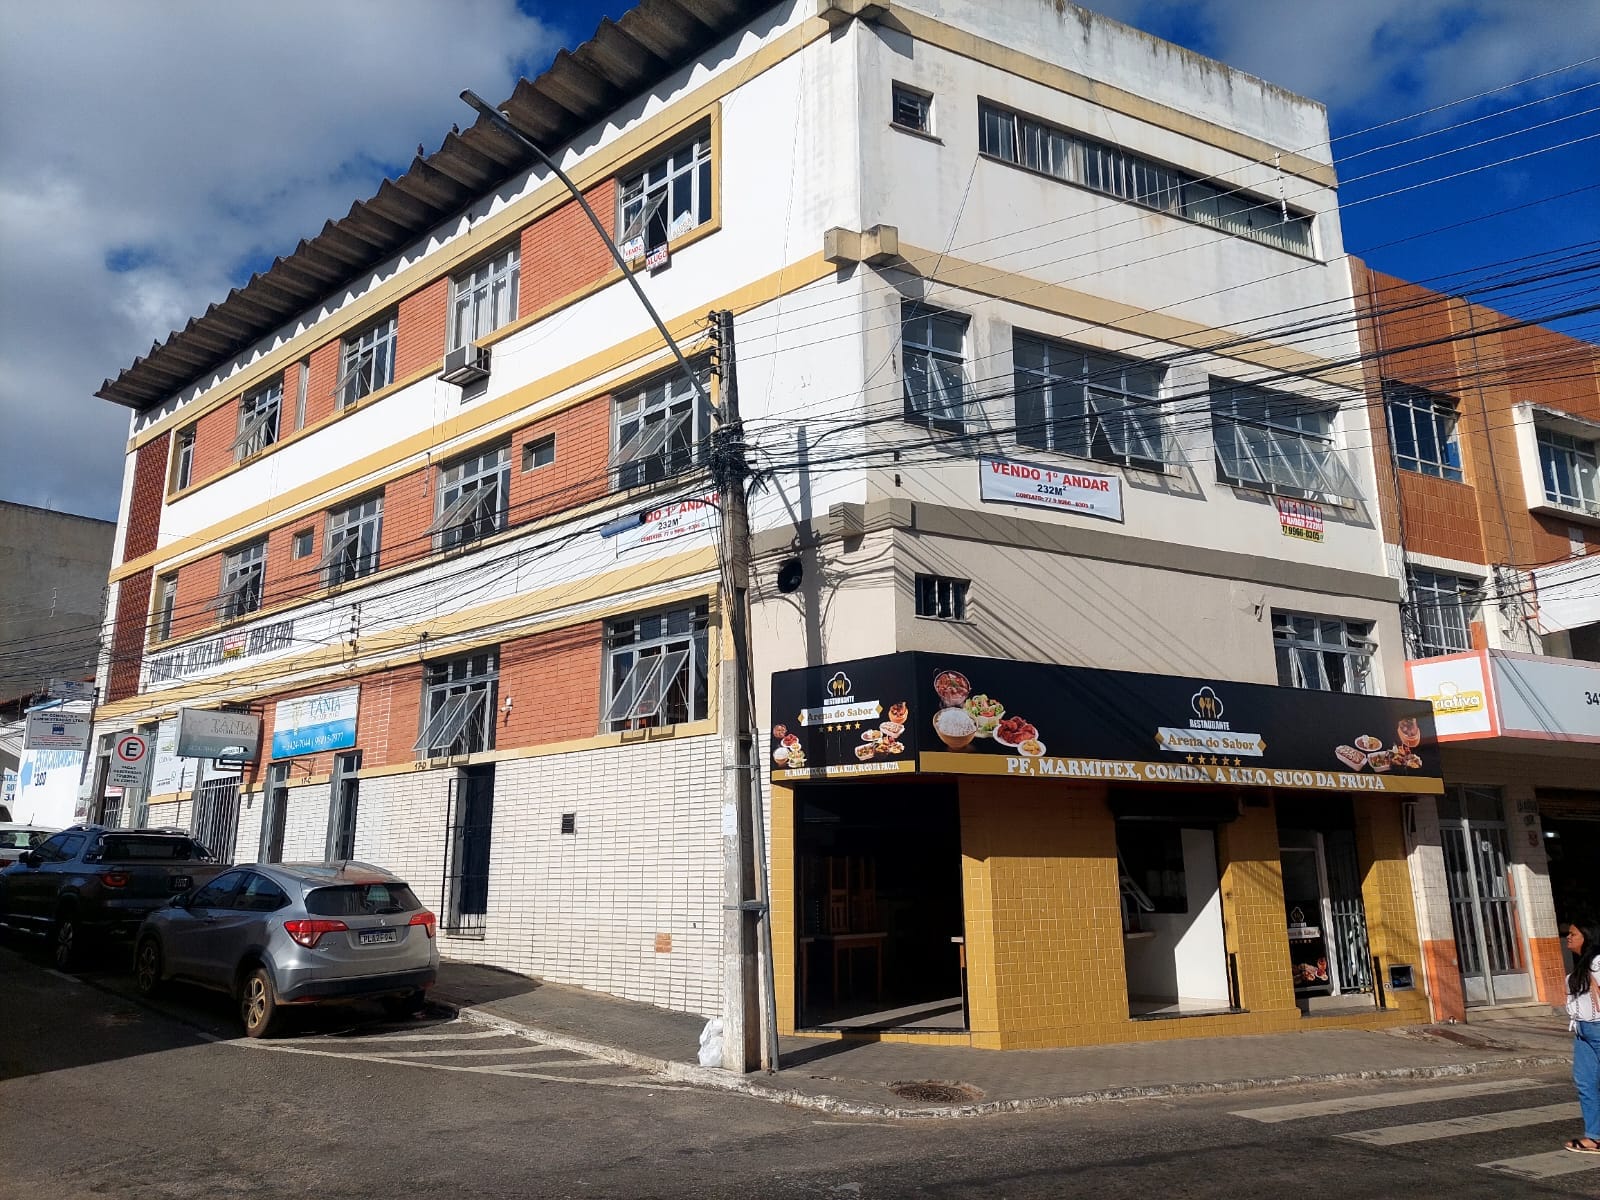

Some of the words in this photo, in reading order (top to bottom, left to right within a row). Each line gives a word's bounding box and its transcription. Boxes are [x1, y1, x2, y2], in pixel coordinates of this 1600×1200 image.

[647, 251, 667, 265] ALUGO
[991, 461, 1041, 480] VENDO
[1045, 472, 1059, 483] 1º
[1062, 475, 1110, 492] ANDAR
[679, 493, 720, 513] ANDAR
[1280, 500, 1322, 522] VENDO
[310, 696, 341, 716] TÂNIA
[1434, 694, 1480, 711] riativa
[807, 711, 833, 721] Arena
[834, 710, 845, 718] do
[846, 707, 874, 717] Sabor
[1189, 718, 1231, 731] RESTAURANTE
[125, 742, 139, 757] E
[1167, 734, 1203, 747] Arena
[1205, 736, 1220, 748] do
[1222, 737, 1255, 751] Sabor
[1006, 757, 1035, 776] PF,
[1038, 758, 1142, 781] MARMITEX,
[1144, 764, 1210, 783] COMIDA
[1215, 769, 1228, 783] A
[1229, 769, 1271, 787] KILO,
[1273, 771, 1314, 787] SUCO
[1315, 774, 1337, 788] DA
[1339, 775, 1386, 790] FRUTA
